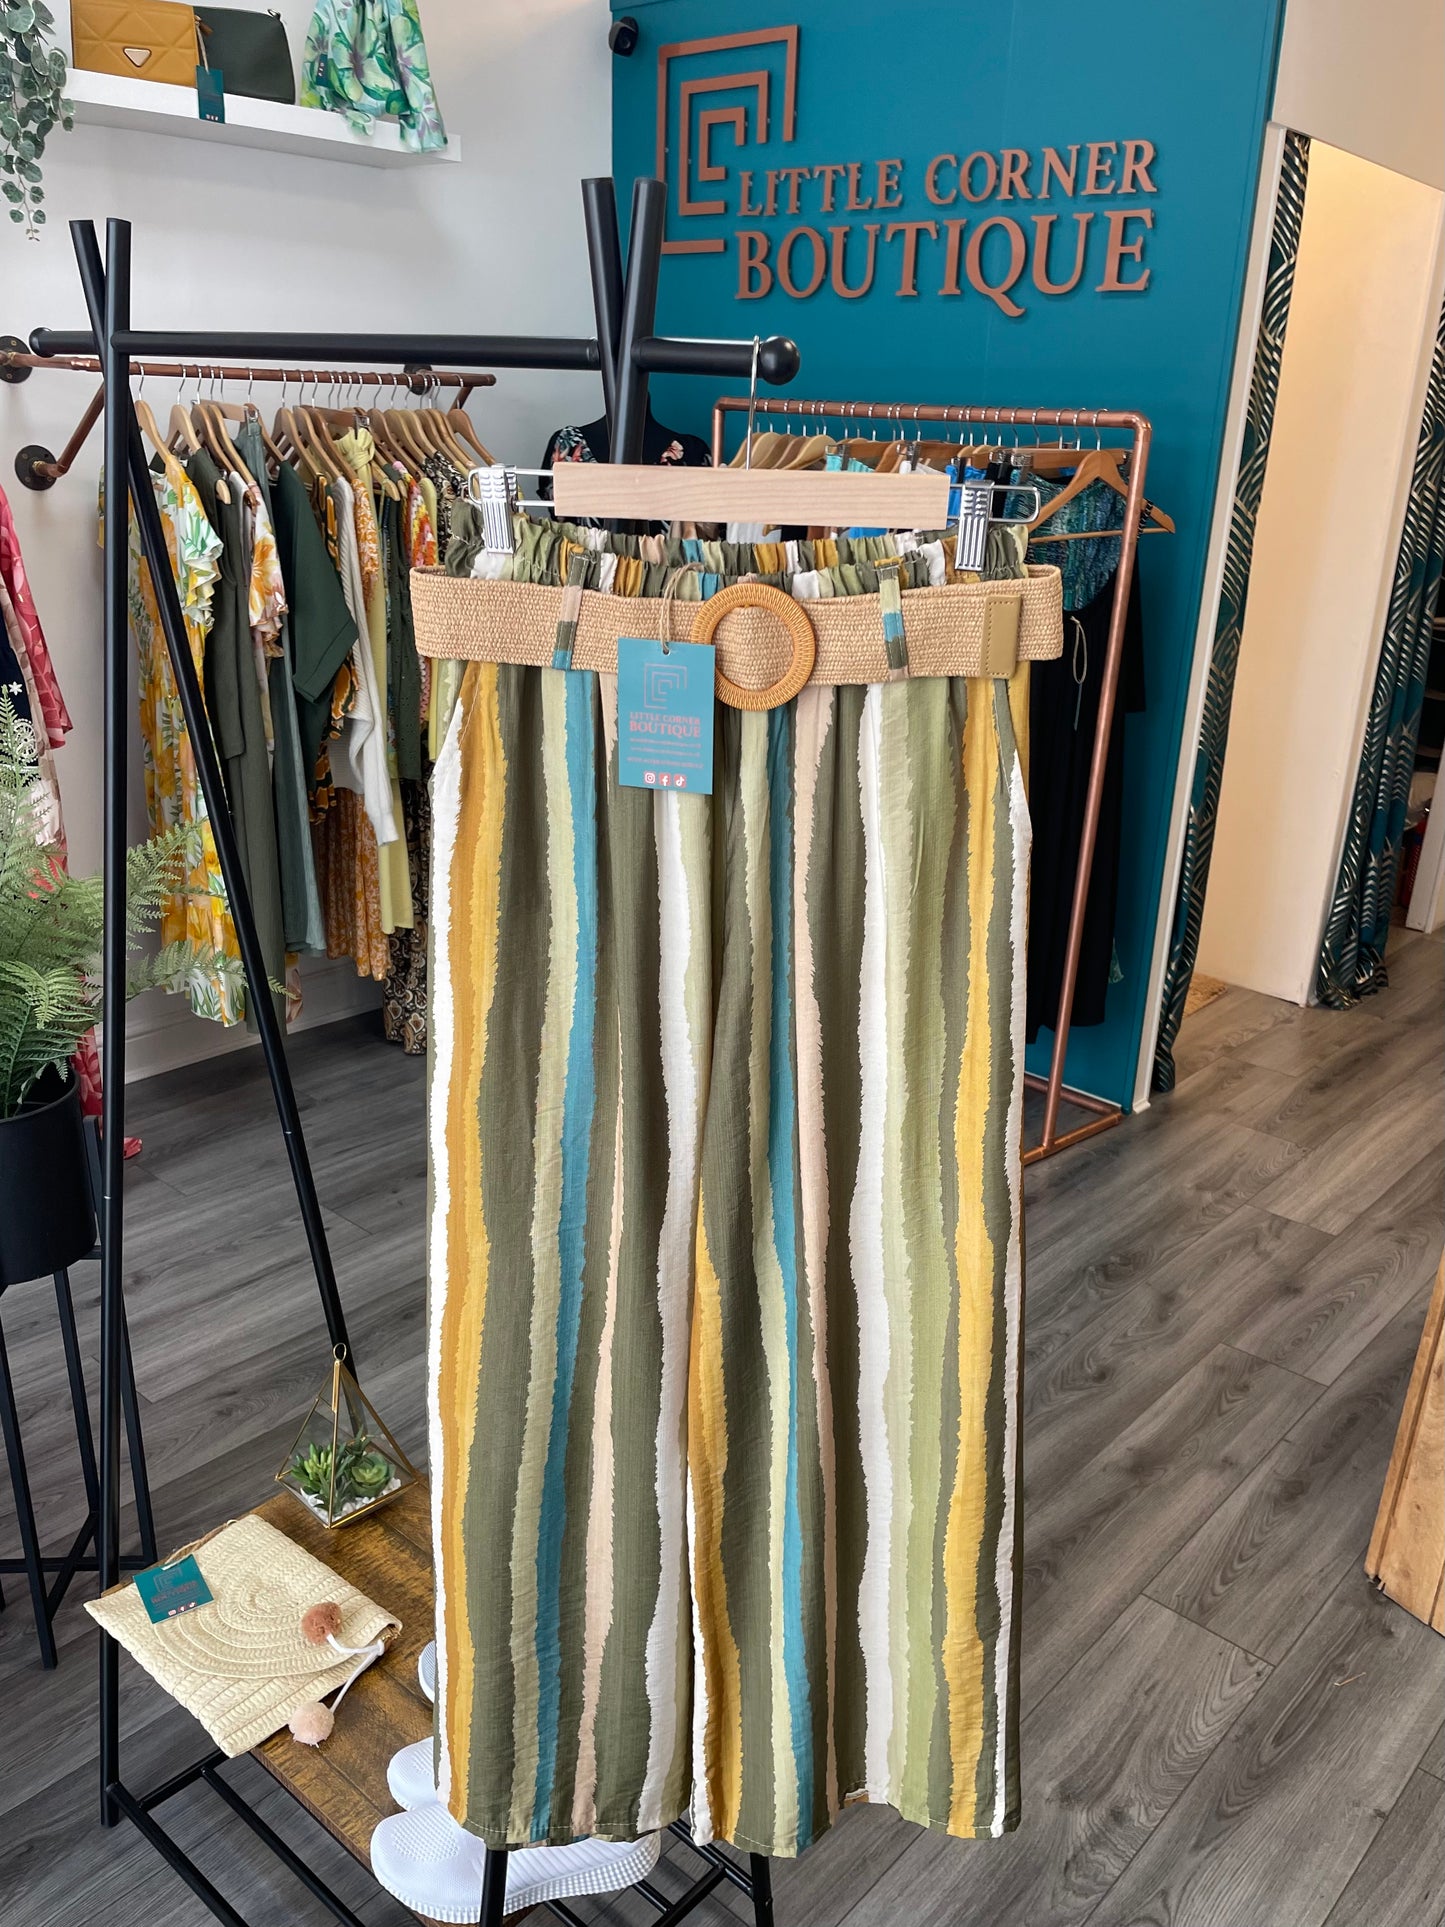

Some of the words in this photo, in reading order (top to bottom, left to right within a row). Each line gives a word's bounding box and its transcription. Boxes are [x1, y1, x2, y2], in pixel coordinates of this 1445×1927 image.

[739, 159, 902, 216] LITTLE
[925, 140, 1157, 204] CORNER
[735, 208, 1154, 317] BOUTIQUE
[630, 720, 701, 739] BOUTIQUE
